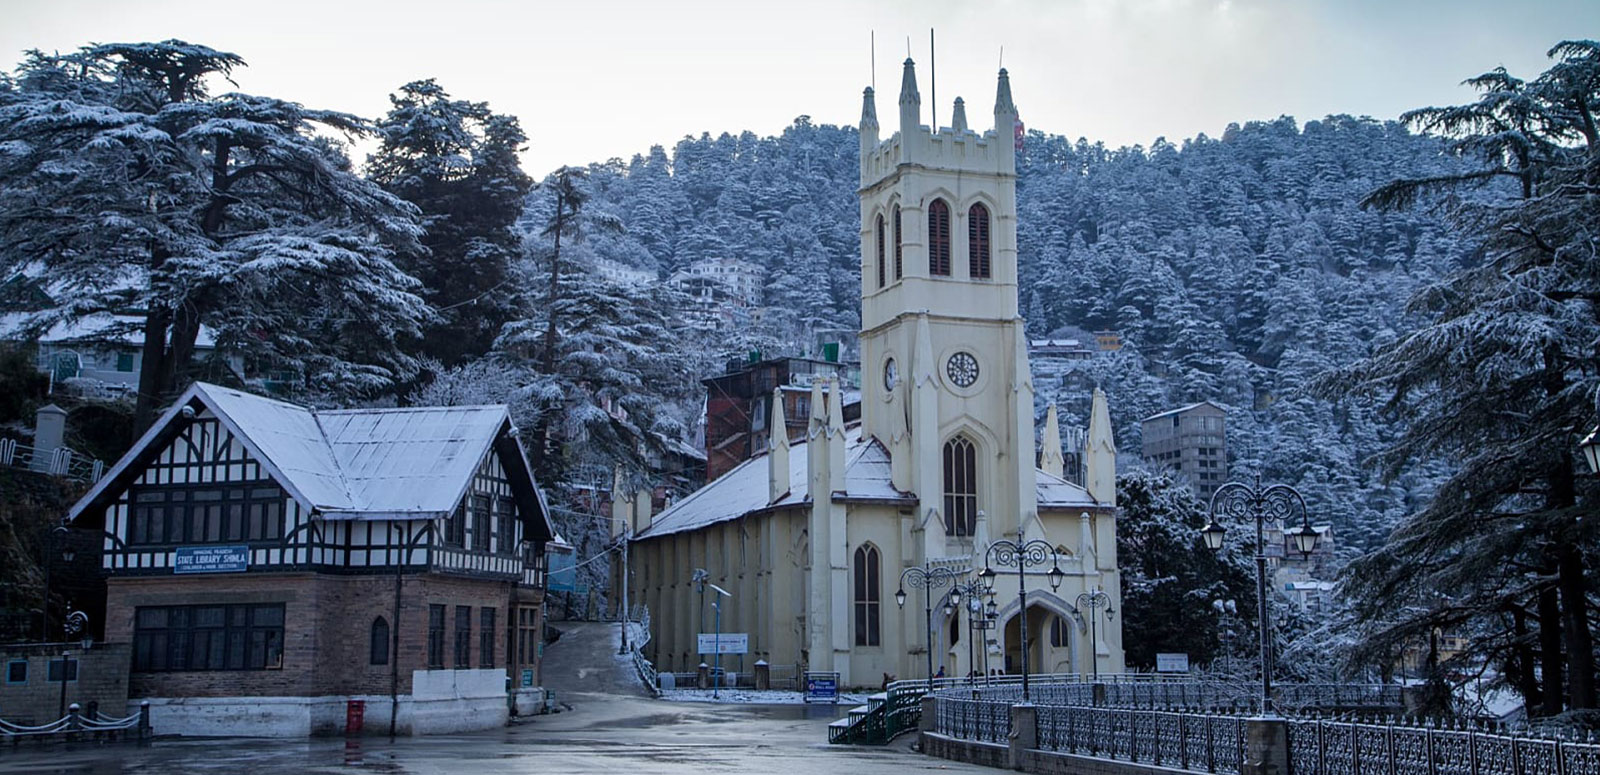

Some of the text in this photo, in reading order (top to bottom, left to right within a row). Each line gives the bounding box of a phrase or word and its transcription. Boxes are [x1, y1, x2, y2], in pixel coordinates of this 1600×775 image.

[178, 554, 245, 564] STATE LIBRARY SHIMLA
